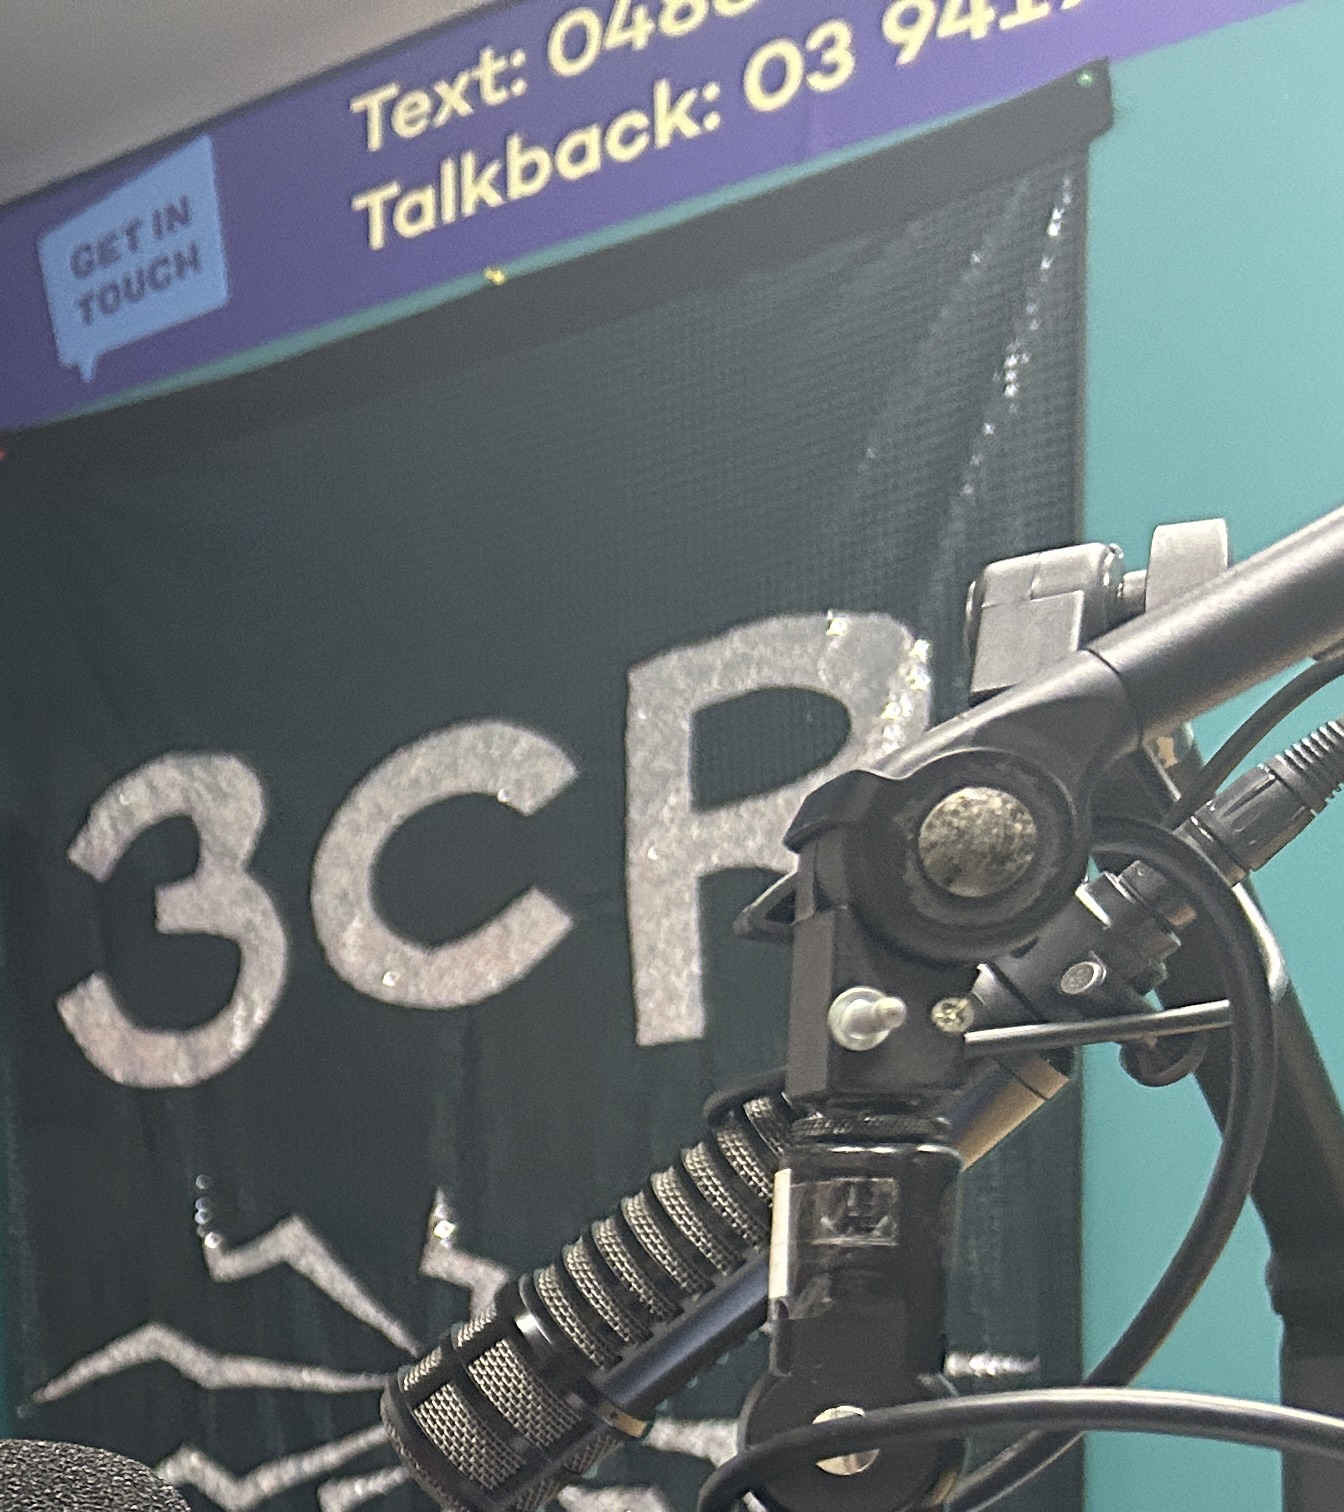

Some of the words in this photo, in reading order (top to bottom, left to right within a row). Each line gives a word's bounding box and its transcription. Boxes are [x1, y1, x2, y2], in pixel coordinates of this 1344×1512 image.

[351, 46, 527, 152] Text:
[548, 0, 762, 78] 048
[353, 79, 721, 250] Talkback:
[743, 20, 855, 113] 03
[880, 0, 1102, 66] 94
[70, 221, 142, 280] GET
[151, 195, 194, 242] IN
[77, 243, 203, 325] TOUCH
[58, 612, 932, 1088] 3CR
